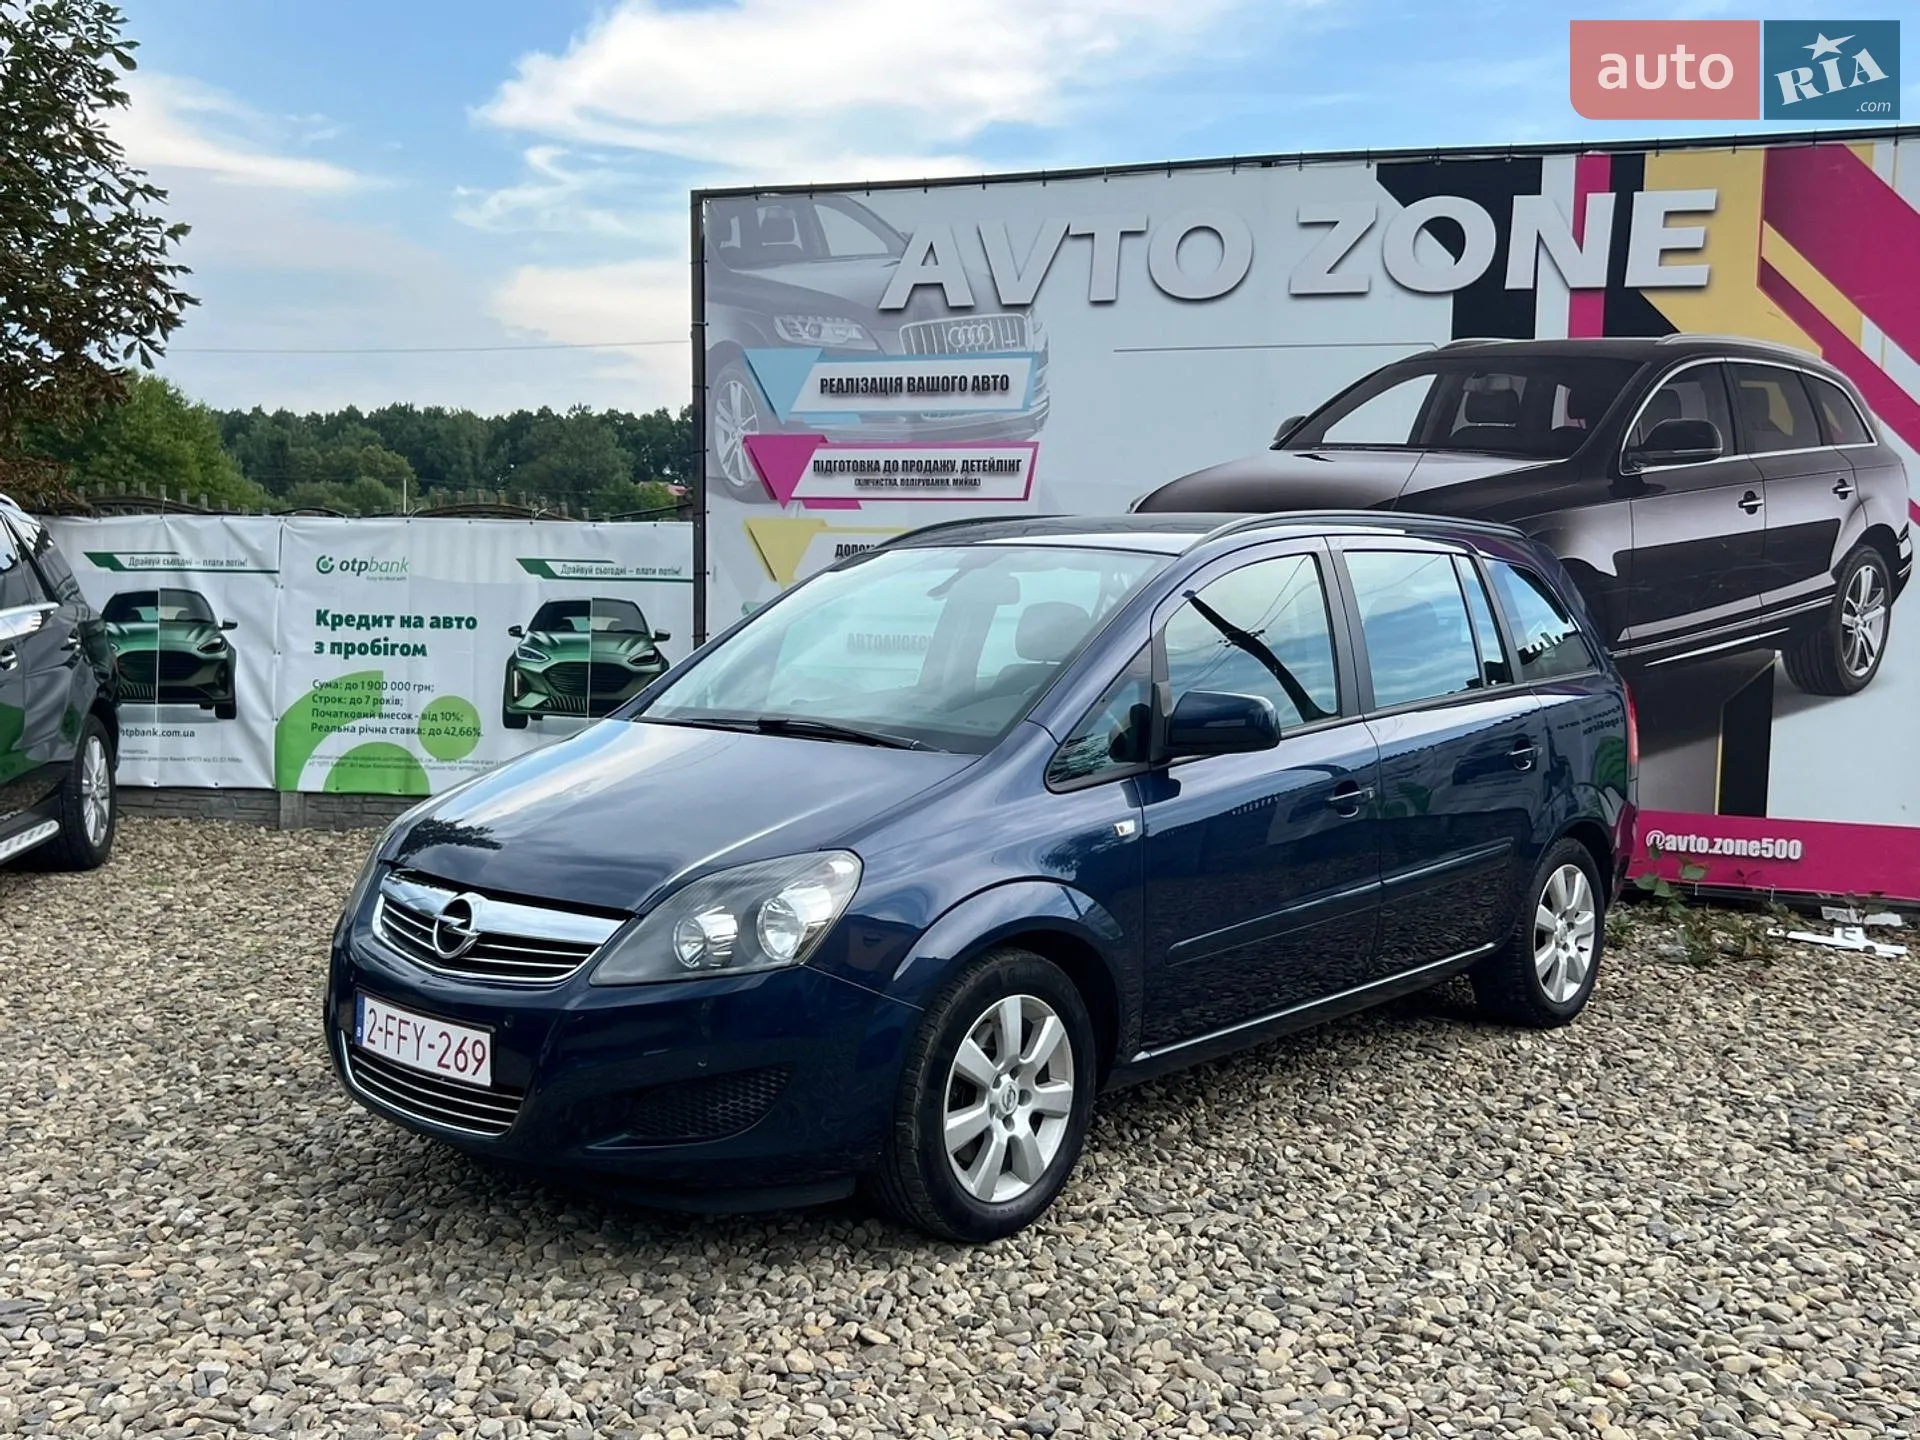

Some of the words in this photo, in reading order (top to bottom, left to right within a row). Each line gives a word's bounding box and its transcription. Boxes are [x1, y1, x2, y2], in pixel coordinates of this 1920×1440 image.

[878, 213, 1254, 311] AVTO
[1289, 189, 1717, 297] ZONE
[820, 376, 903, 396] РЕАЛІЗАЦІЯ
[907, 374, 968, 393] ВАШОГО
[971, 374, 1010, 392] АВТО
[813, 459, 881, 473] ПІДГОТОВКА
[883, 459, 899, 474] ДО
[961, 456, 1022, 473] ДЕТЕЙЛІНГ
[339, 555, 409, 577] otpbank
[560, 564, 592, 576] Драйвуй
[595, 566, 627, 576] сьогодні
[636, 567, 656, 576] плати
[315, 609, 395, 631] Кредит
[400, 615, 424, 629] на
[429, 615, 478, 629] авто
[314, 640, 325, 654] з
[330, 636, 427, 659] пробігом
[312, 679, 343, 691] Сума:
[344, 681, 359, 691] до
[390, 682, 411, 692] 000
[413, 683, 435, 693] грн;
[311, 694, 347, 705] Строк:
[349, 696, 363, 705] до
[365, 696, 370, 704] 7
[372, 695, 404, 706] років;
[311, 708, 376, 719] Початковий
[378, 712, 413, 721] внесок
[421, 711, 438, 722] від
[440, 711, 464, 722] 10%;
[310, 723, 356, 733] Реальна
[358, 724, 387, 735] річна
[389, 726, 426, 735] ставка:
[428, 727, 443, 736] до
[1646, 830, 1802, 860] @avto.zone500
[367, 1007, 487, 1076] 2-FFY-269
